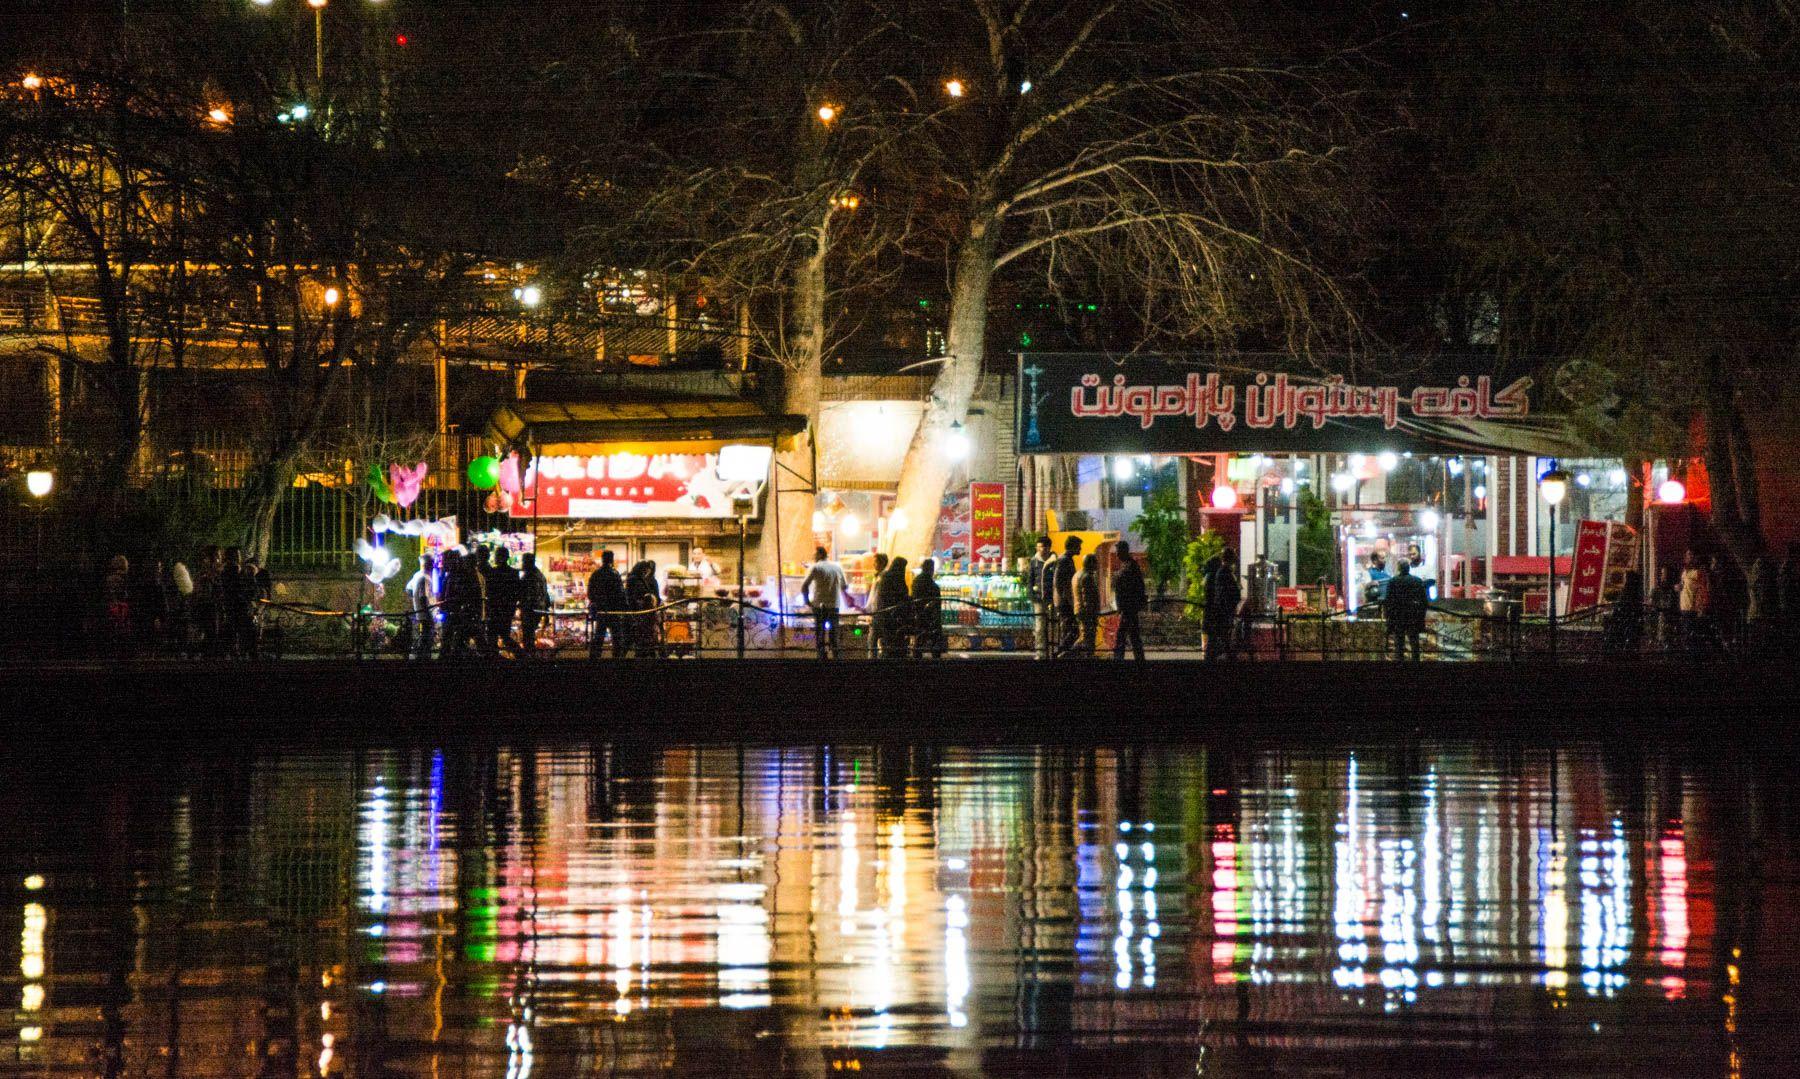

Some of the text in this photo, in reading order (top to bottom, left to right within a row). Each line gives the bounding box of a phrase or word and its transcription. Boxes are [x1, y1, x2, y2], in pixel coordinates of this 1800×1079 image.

[1071, 372, 1534, 432] کافه رستوران پارامونت
[585, 487, 655, 496] CREAM
[974, 509, 1002, 520] ساندویچ
